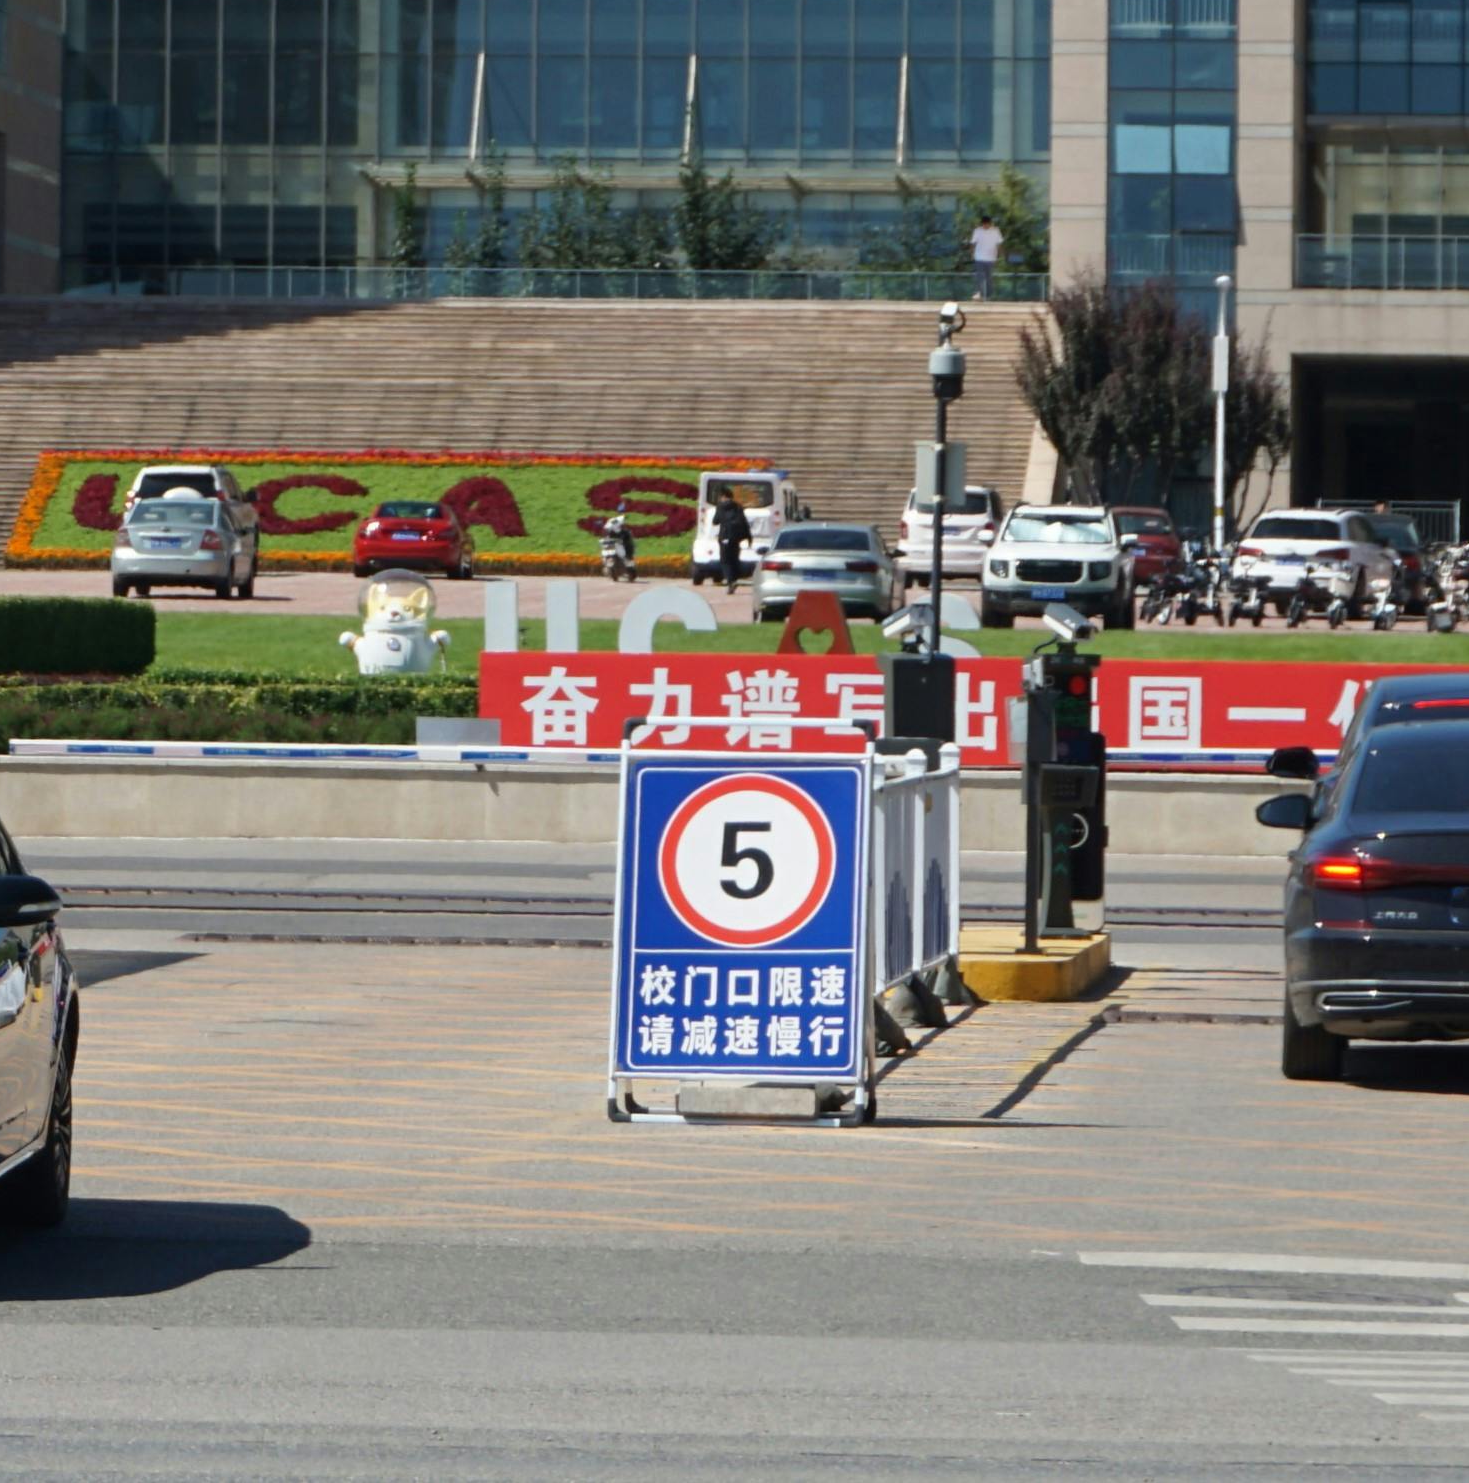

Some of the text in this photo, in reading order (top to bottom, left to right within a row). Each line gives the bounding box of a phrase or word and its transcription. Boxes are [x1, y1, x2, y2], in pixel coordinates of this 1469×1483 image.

[720, 821, 774, 900] 5
[639, 964, 846, 1007] 校门口限速
[638, 1013, 845, 1057] 请减速慢行
